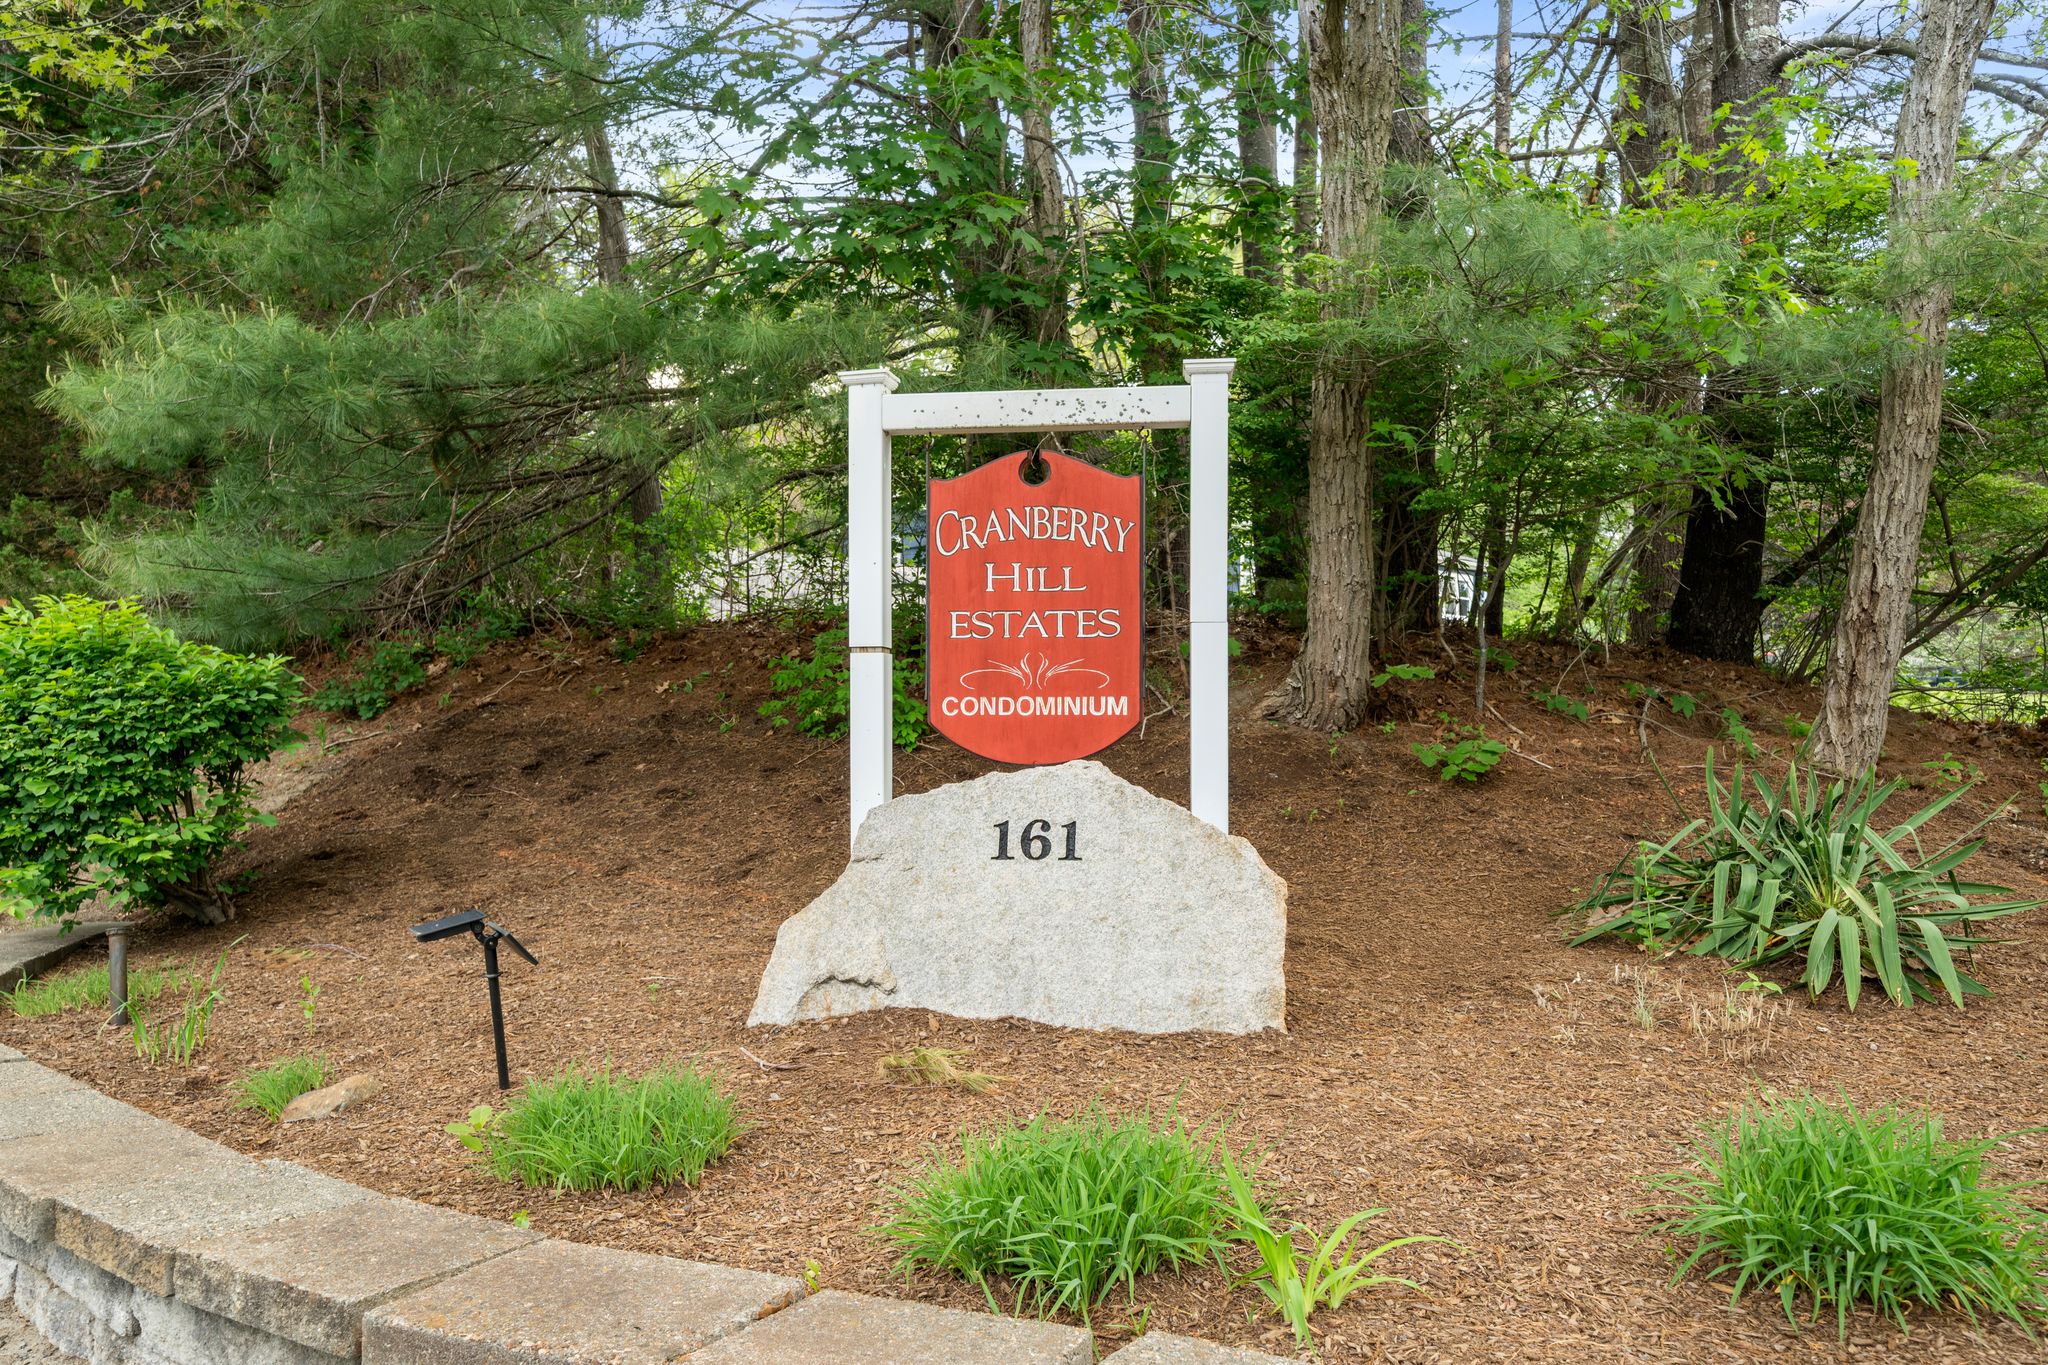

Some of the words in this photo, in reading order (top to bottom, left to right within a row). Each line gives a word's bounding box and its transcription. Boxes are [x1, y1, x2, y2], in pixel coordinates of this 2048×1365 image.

[935, 506, 1135, 556] CRANBERRY
[985, 562, 1087, 592] HILL
[949, 609, 1121, 639] ESTATES
[941, 695, 1128, 717] CONDOMINIUM
[991, 819, 1083, 861] 161
